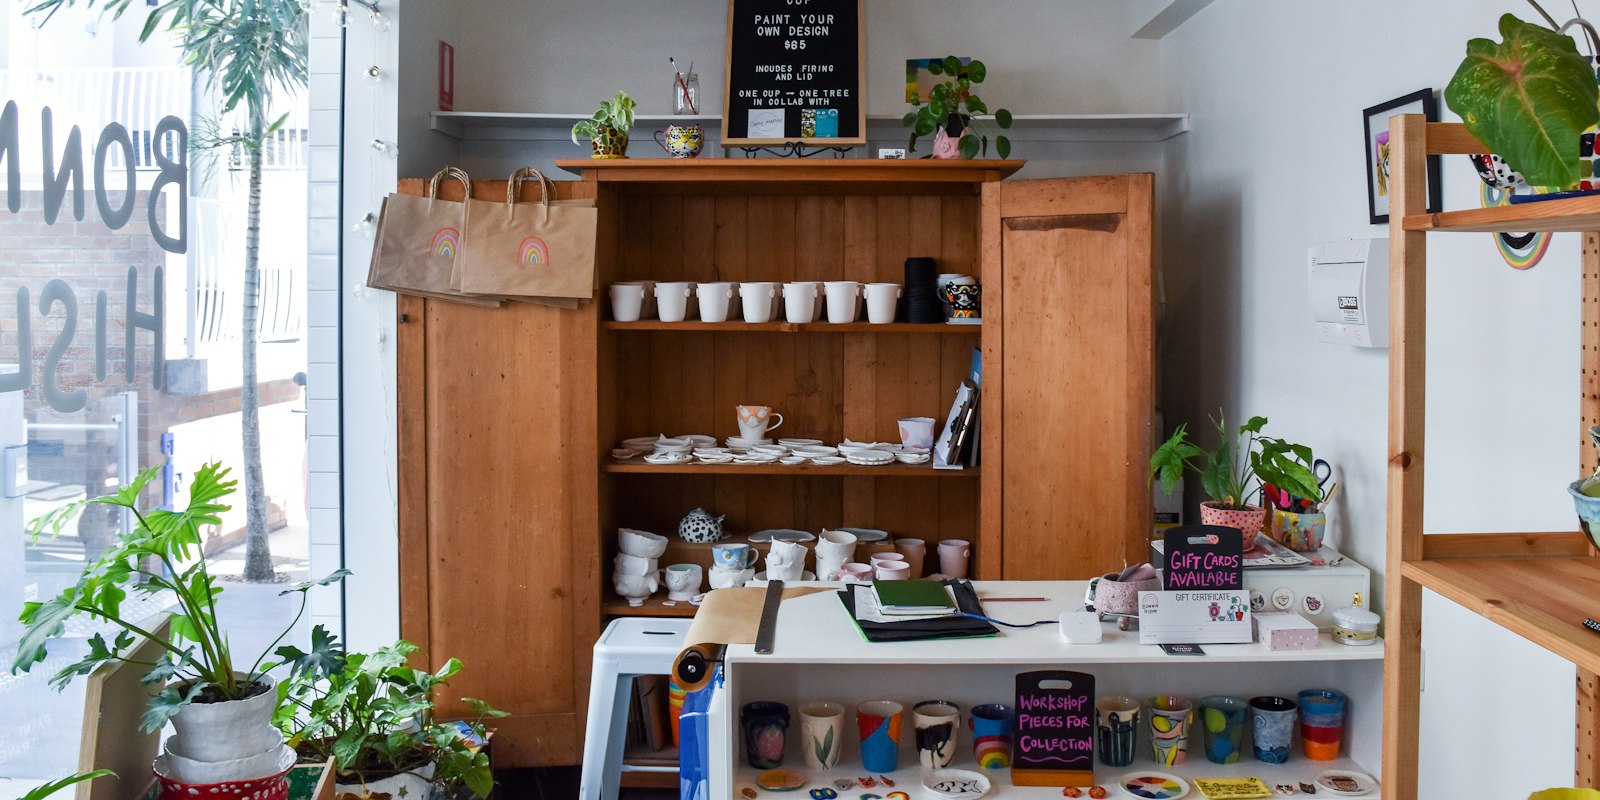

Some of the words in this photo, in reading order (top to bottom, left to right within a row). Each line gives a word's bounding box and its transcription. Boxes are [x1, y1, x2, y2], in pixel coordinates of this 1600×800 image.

[755, 14, 790, 24] PAINT
[800, 14, 834, 24] YOUR
[757, 26, 780, 36] OWN
[789, 26, 829, 36] DESIGN
[784, 40, 806, 50] $65
[802, 65, 834, 73] FIRING
[775, 73, 792, 81] AND
[796, 73, 813, 81] LID
[753, 98, 763, 106] IN
[768, 98, 803, 106] COLLAB
[809, 98, 830, 106] WITH
[1171, 551, 1202, 570] GIFT
[1203, 551, 1240, 570] CARDS
[1169, 571, 1238, 587] AVAILABLE
[1175, 593, 1189, 601] GIFT
[1191, 592, 1231, 601] CERTIFICATE
[1020, 694, 1087, 711] WORKSHOP
[1020, 714, 1063, 731] PIECES
[1066, 715, 1090, 729] FOR
[1020, 735, 1093, 753] COLLECTION
